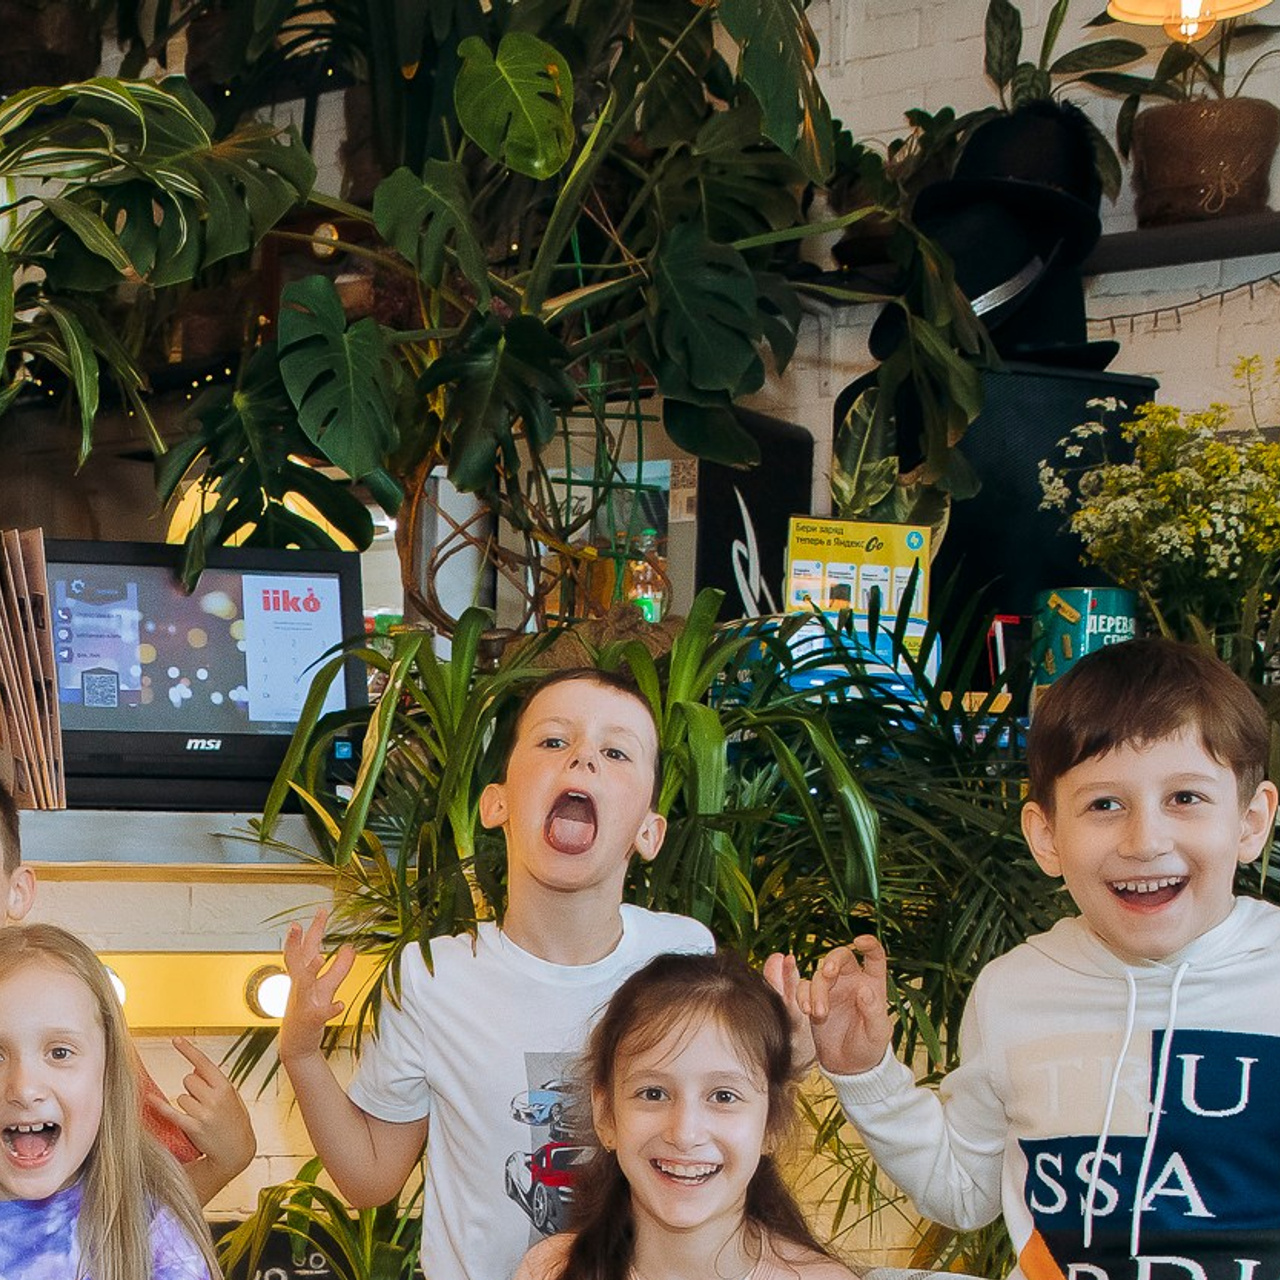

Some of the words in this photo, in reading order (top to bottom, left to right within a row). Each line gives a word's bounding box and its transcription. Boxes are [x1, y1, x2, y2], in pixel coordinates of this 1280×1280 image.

[795, 523, 818, 534] Бери
[795, 536, 825, 547] теперь
[833, 537, 865, 549] Яндекс
[262, 588, 321, 612] iiko
[186, 738, 222, 751] msi
